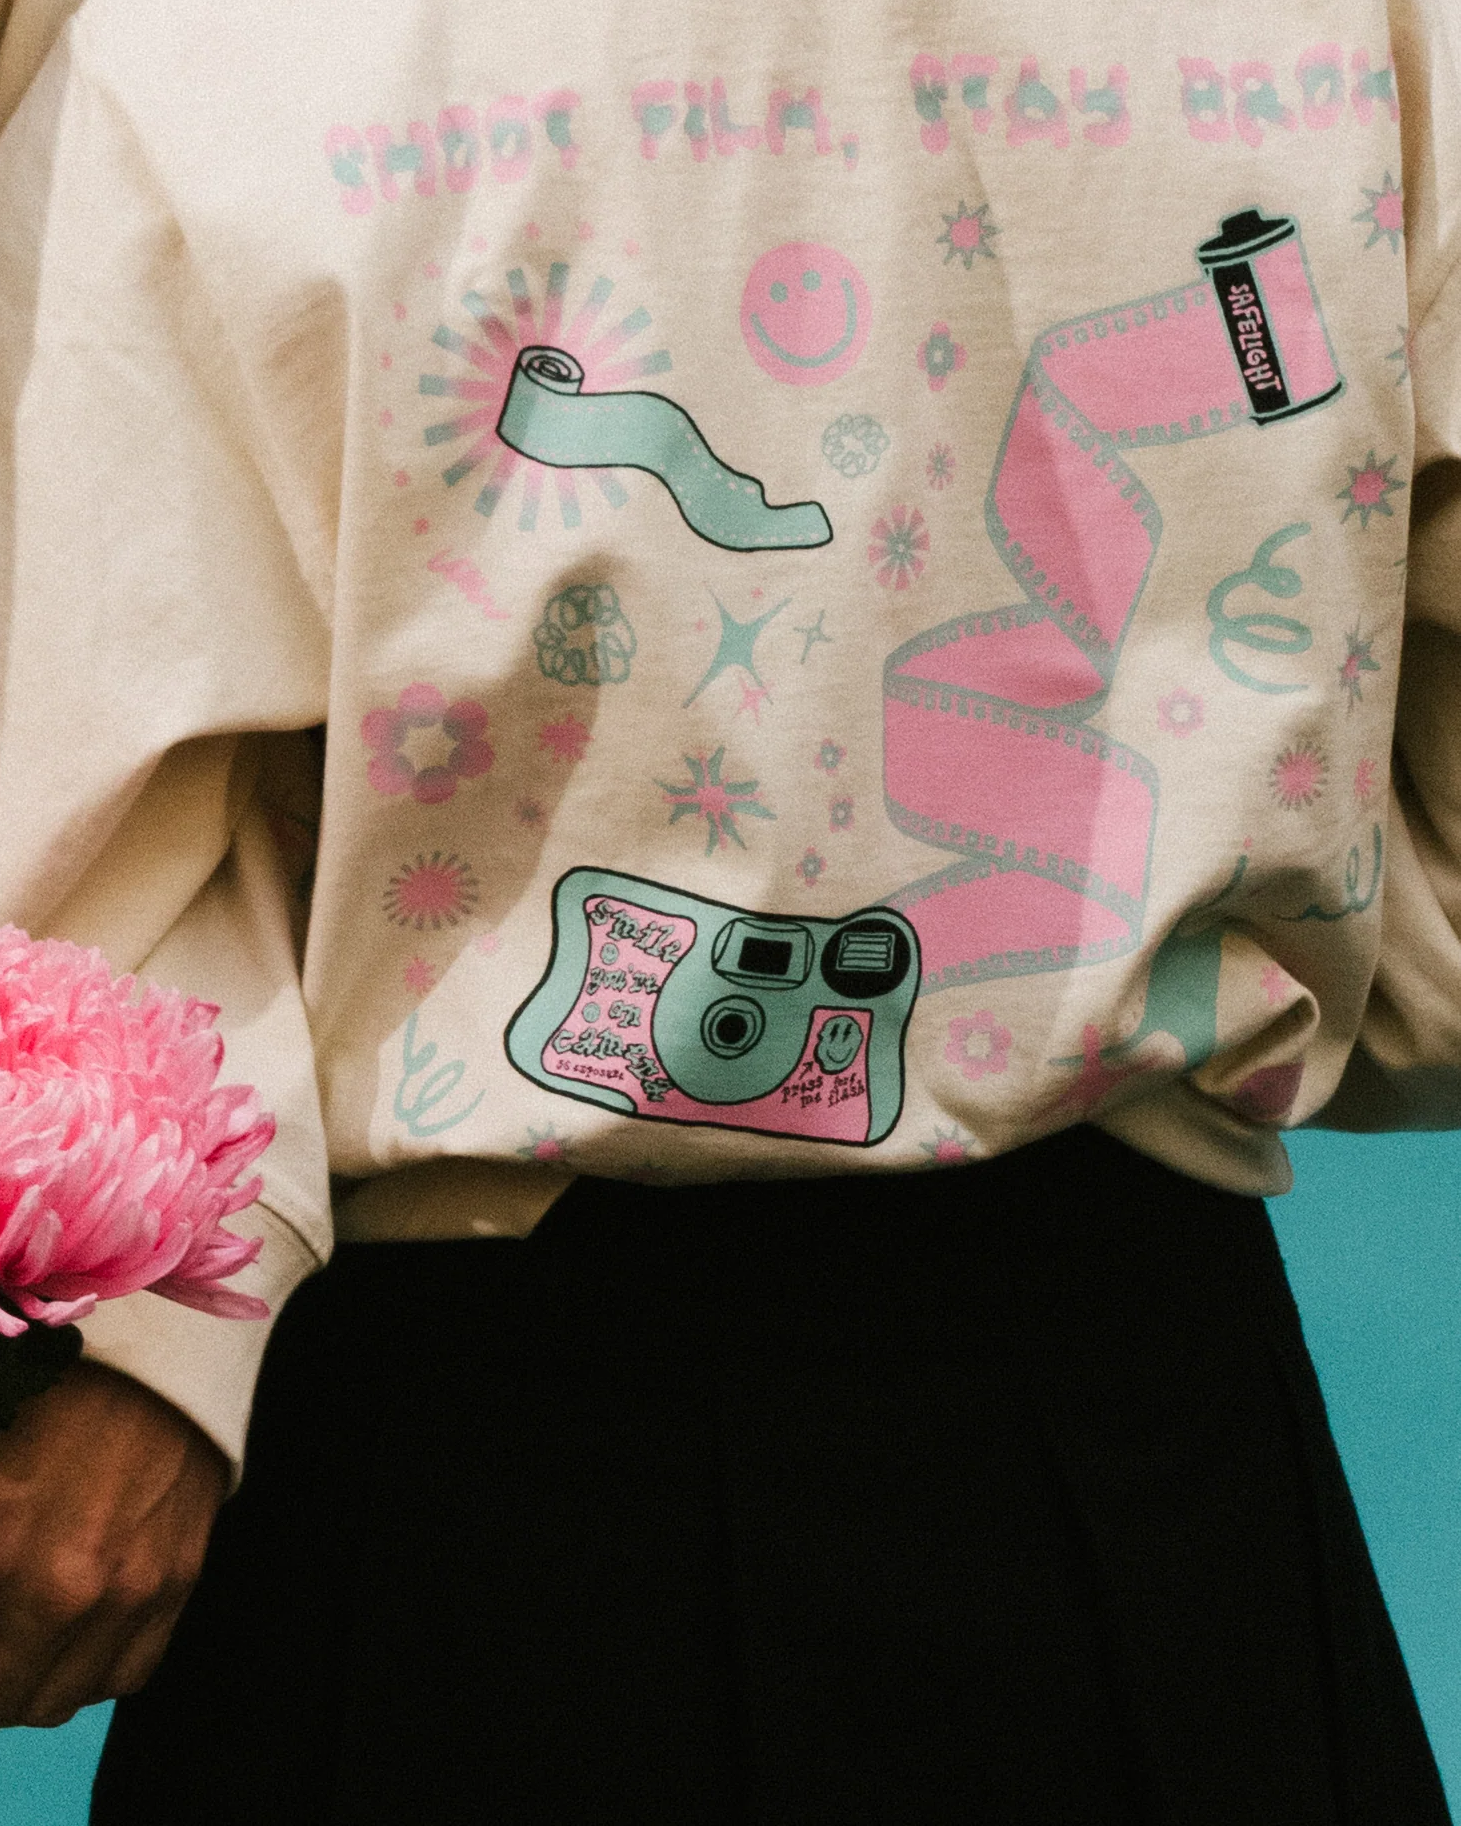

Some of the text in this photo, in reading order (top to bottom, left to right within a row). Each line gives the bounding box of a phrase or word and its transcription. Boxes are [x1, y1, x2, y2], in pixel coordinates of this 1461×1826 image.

[324, 41, 1400, 215] SHOOT FILM, STAY BROK
[1227, 283, 1283, 392] SAFELIGHT
